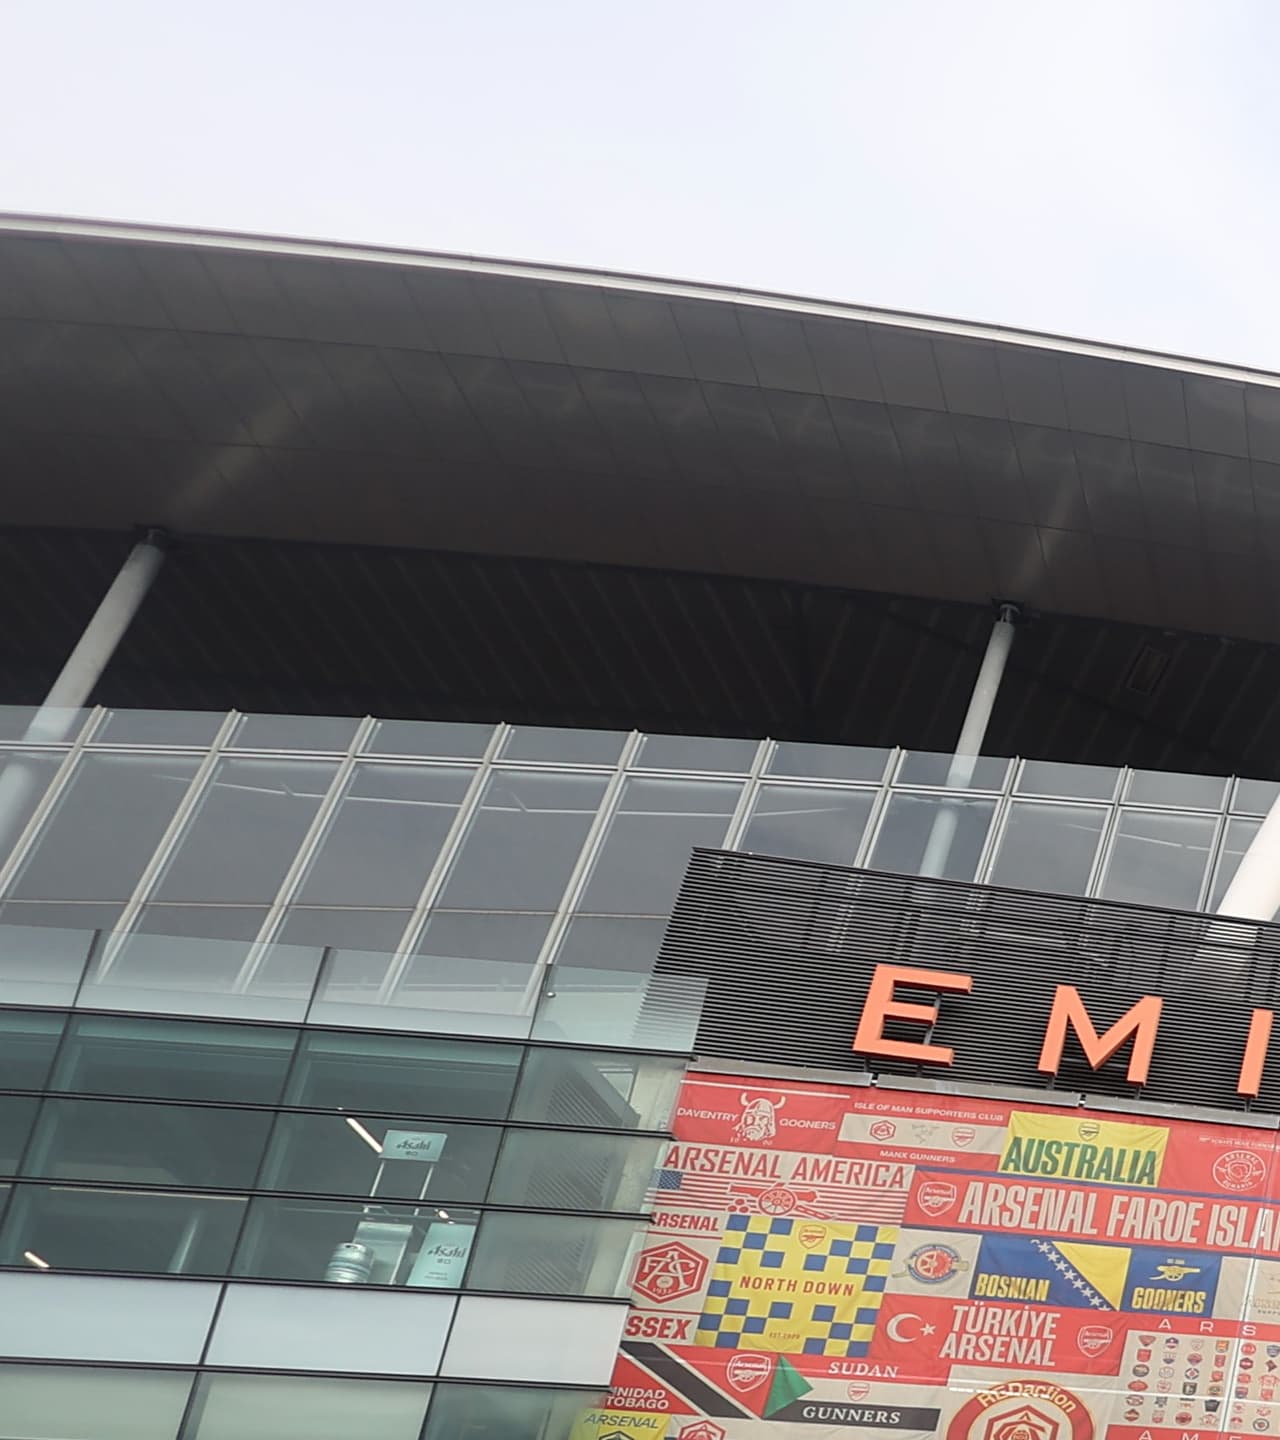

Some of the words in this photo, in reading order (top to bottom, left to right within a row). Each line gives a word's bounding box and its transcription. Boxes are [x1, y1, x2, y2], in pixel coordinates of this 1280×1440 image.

[677, 1107, 739, 1122] DAVENTRY
[780, 1118, 836, 1131] GOONERS
[854, 1102, 876, 1111] ISLE
[879, 1104, 890, 1112] OF
[893, 1105, 912, 1114] MAN
[915, 1107, 975, 1120] SUPPORTERS
[978, 1113, 1003, 1121] CLUB
[663, 1145, 782, 1179] ARSENAL
[793, 1158, 905, 1188] AMERICA
[1002, 1137, 1158, 1186] AUSTRALIA
[957, 1181, 1098, 1236] ARSENAL
[1106, 1193, 1204, 1243] FAROE
[739, 1276, 797, 1292] NORTH
[803, 1281, 855, 1296] DOWN
[951, 1304, 1061, 1334] TÜRKİYE
[939, 1335, 1056, 1367] ARSENAL
